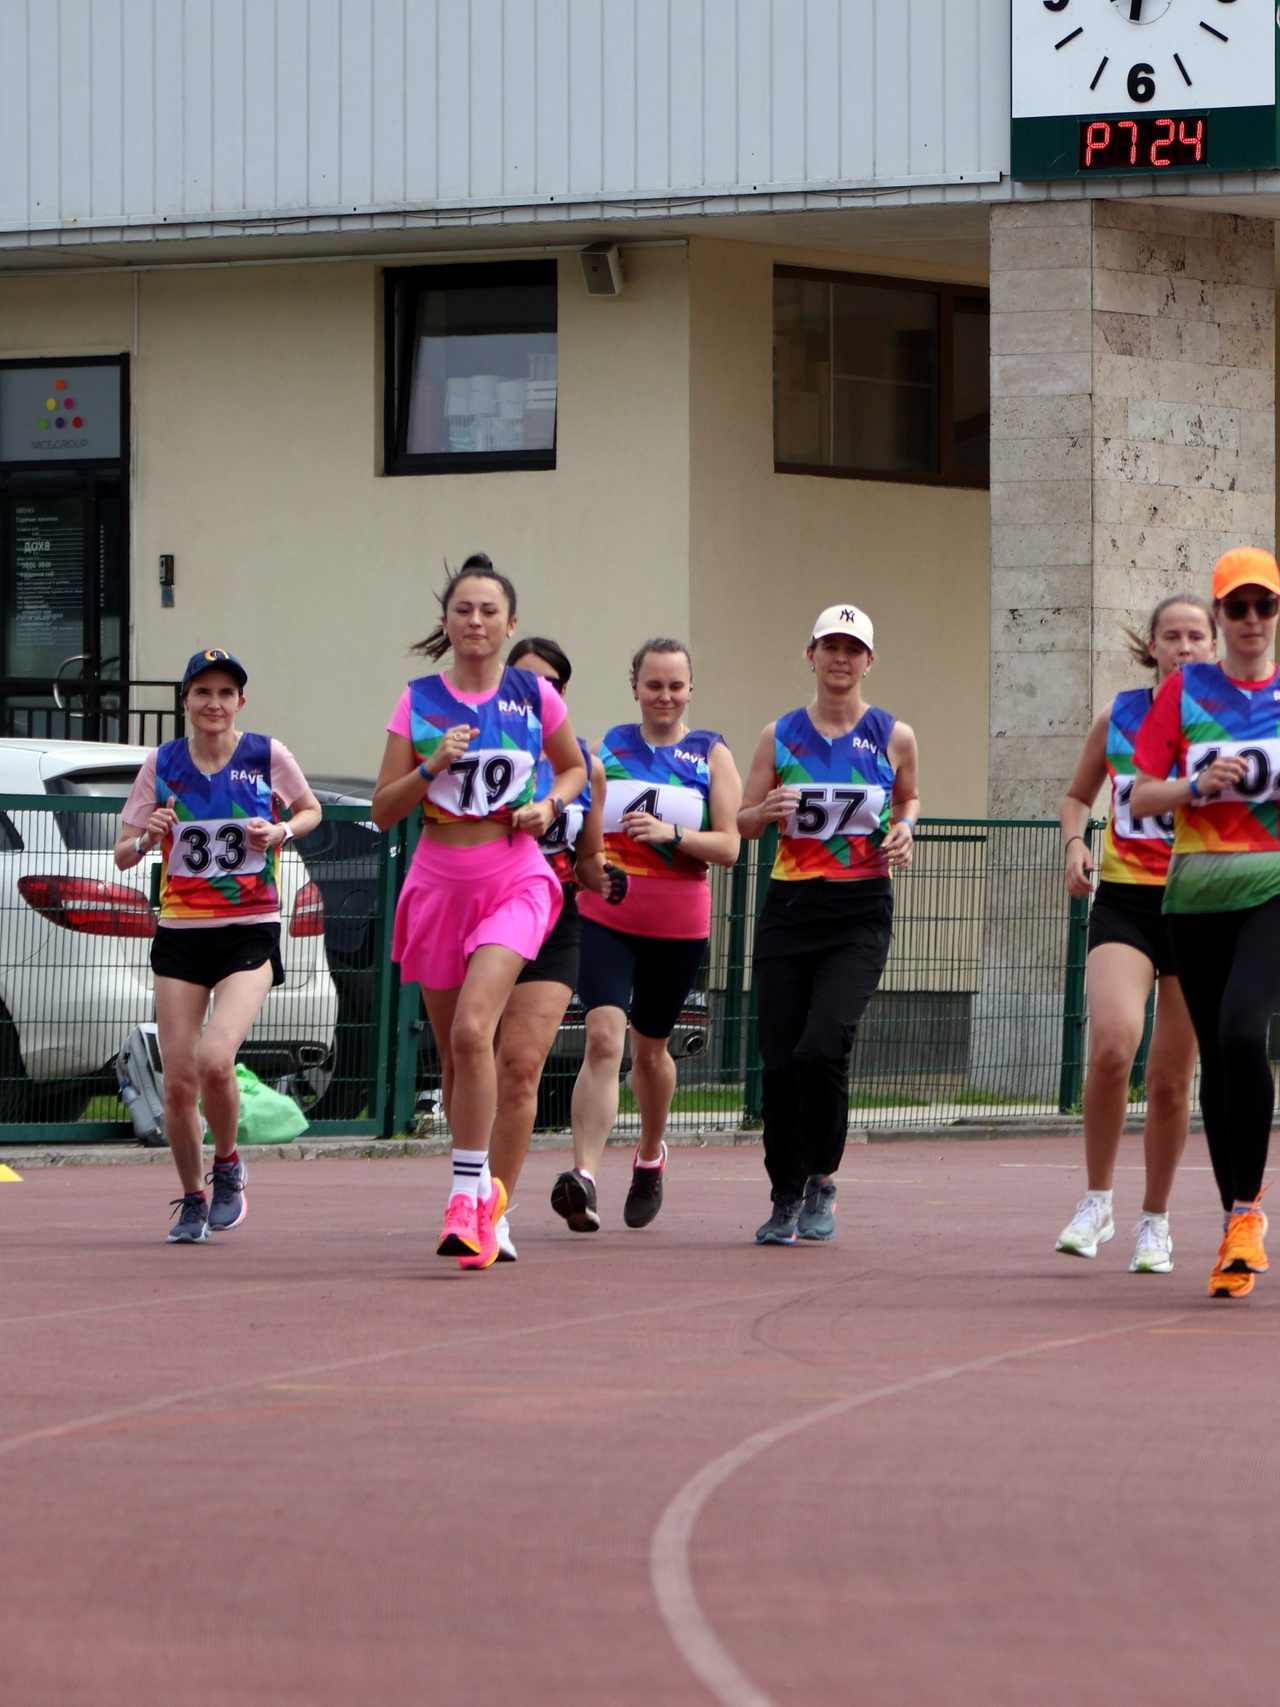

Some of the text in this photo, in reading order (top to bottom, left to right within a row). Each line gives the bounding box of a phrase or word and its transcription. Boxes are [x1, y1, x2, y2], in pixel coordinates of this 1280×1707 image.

[1127, 62, 1156, 103] 6
[498, 699, 534, 717] RAVE
[231, 769, 264, 785] RAVE
[447, 755, 515, 811] 79
[795, 788, 868, 835] 57
[180, 823, 247, 875] 33
